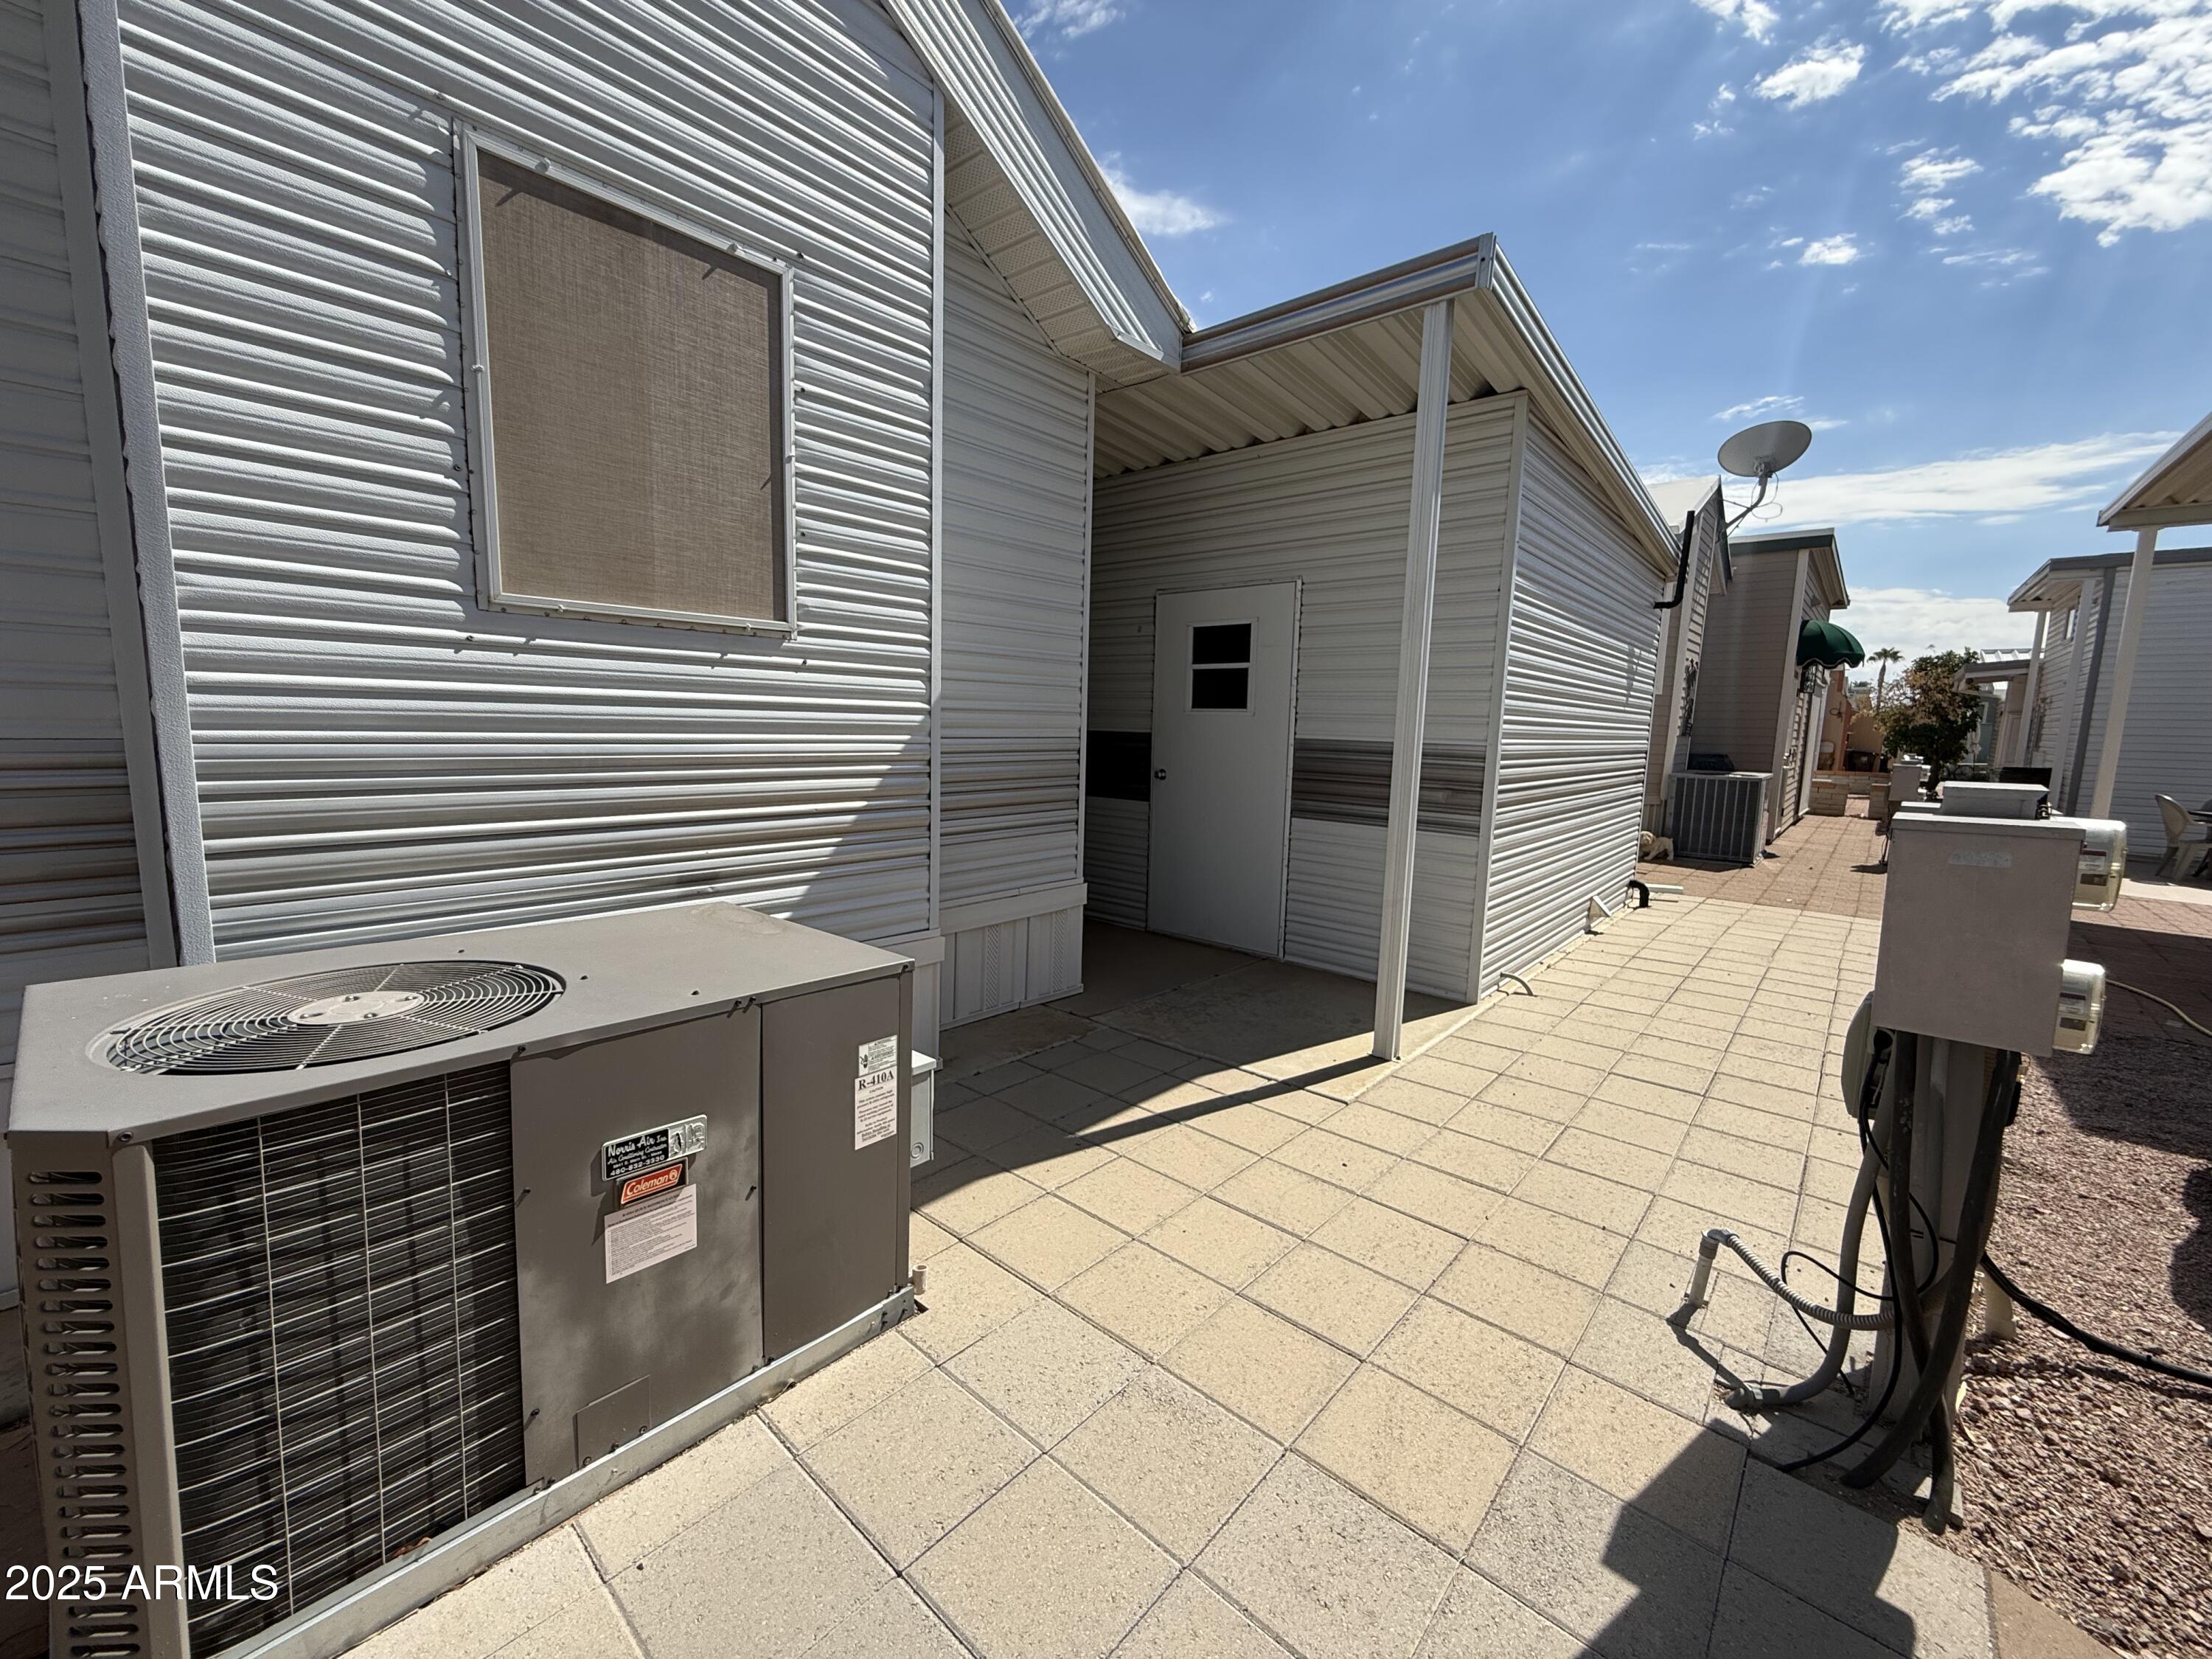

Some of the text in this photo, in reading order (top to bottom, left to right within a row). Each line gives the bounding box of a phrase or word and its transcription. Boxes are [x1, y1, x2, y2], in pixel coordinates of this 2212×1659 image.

[858, 1070, 894, 1091] R-410A
[608, 1141, 636, 1157] Norris
[636, 1135, 655, 1148] Air
[618, 1150, 644, 1162] Conditioning
[627, 1175, 669, 1195] Coleman
